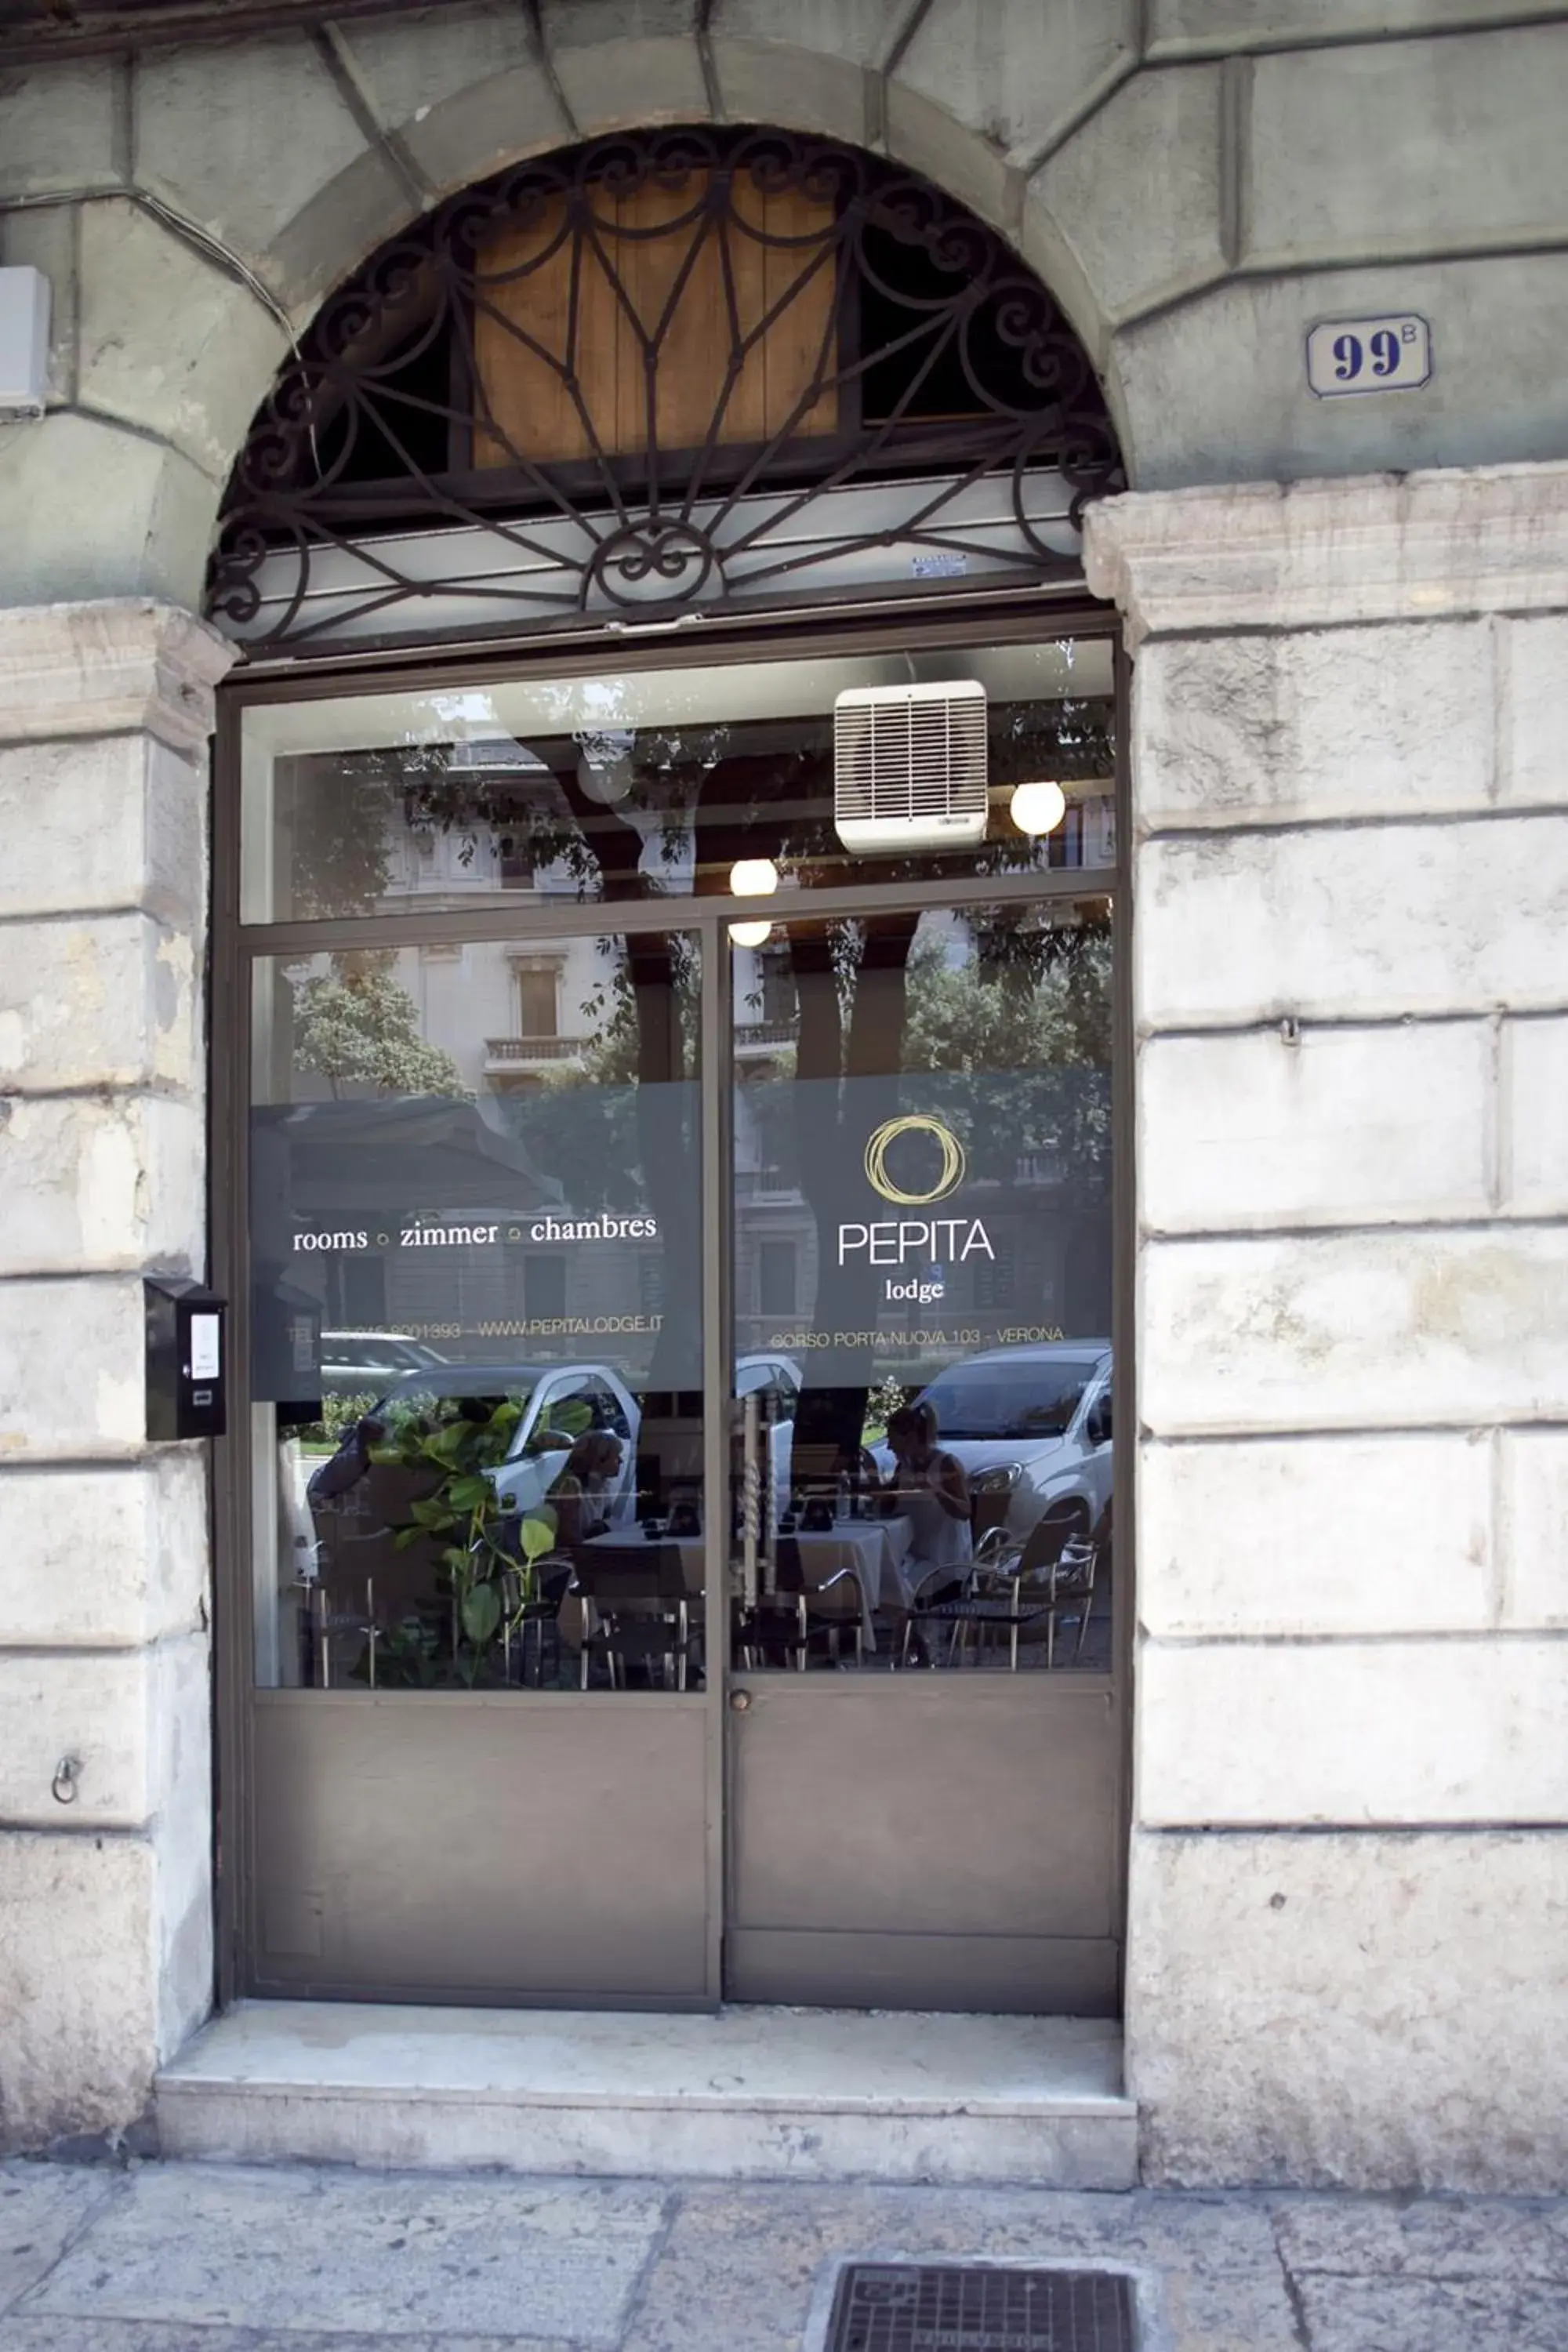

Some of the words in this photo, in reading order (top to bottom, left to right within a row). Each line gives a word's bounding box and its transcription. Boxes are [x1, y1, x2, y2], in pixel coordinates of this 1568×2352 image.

[1333, 329, 1400, 380] 99
[292, 1229, 368, 1251] rooms
[400, 1221, 499, 1247] zimmer
[530, 1214, 658, 1242] chambres
[838, 1218, 995, 1266] PEPITA
[885, 1279, 945, 1304] lodge
[477, 1315, 665, 1337] WWW.PEPITALODGE.IT
[771, 1333, 830, 1348] CORSO
[834, 1331, 887, 1347] PORTA
[891, 1330, 947, 1345] NUOVA
[954, 1329, 980, 1344] 103
[996, 1327, 1065, 1342] VERONA
